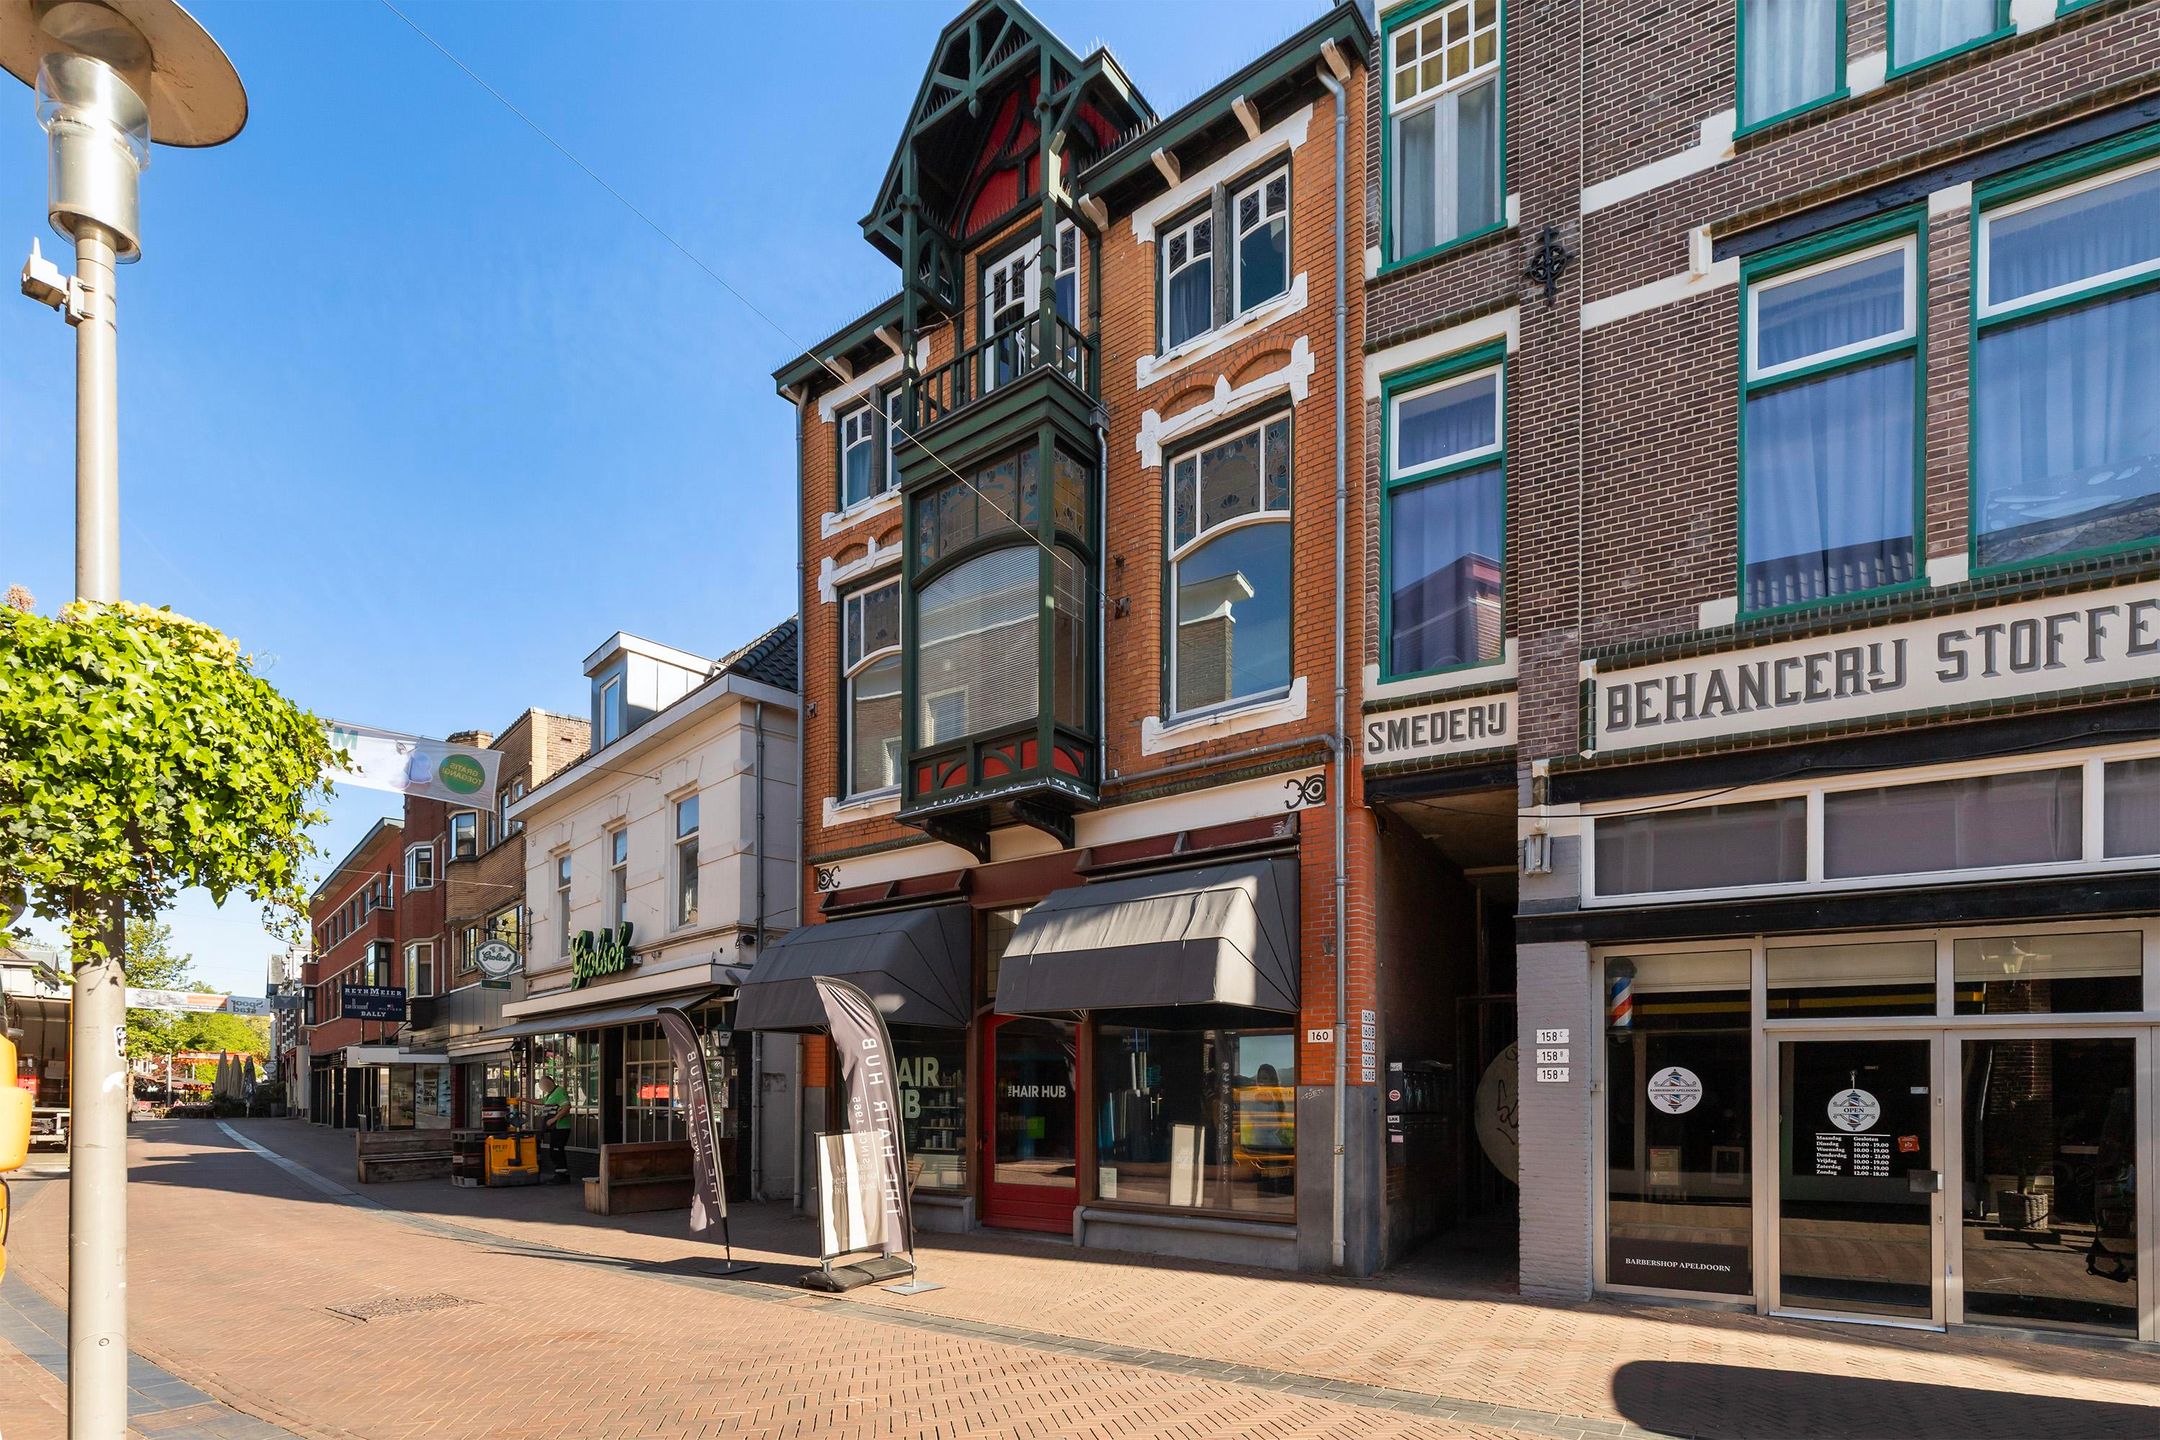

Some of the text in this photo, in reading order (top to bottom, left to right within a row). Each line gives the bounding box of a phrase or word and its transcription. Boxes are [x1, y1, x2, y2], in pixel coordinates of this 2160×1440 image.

[1605, 639, 1909, 733] BEHANGERIJ
[1368, 702, 1507, 755] SMEDERIJ
[482, 950, 512, 963] Grolsch
[570, 921, 633, 991] Grolsch
[1362, 1012, 1375, 1022] 160A
[1312, 1031, 1329, 1041] 160
[1362, 1026, 1375, 1037] 160B
[1362, 1041, 1375, 1051] 160C
[899, 1057, 940, 1087] AIR
[1362, 1071, 1375, 1081] 160E
[1012, 1085, 1066, 1098] HAIR HUB
[1625, 1258, 1731, 1272] BARBERSHOP APELDOORN
